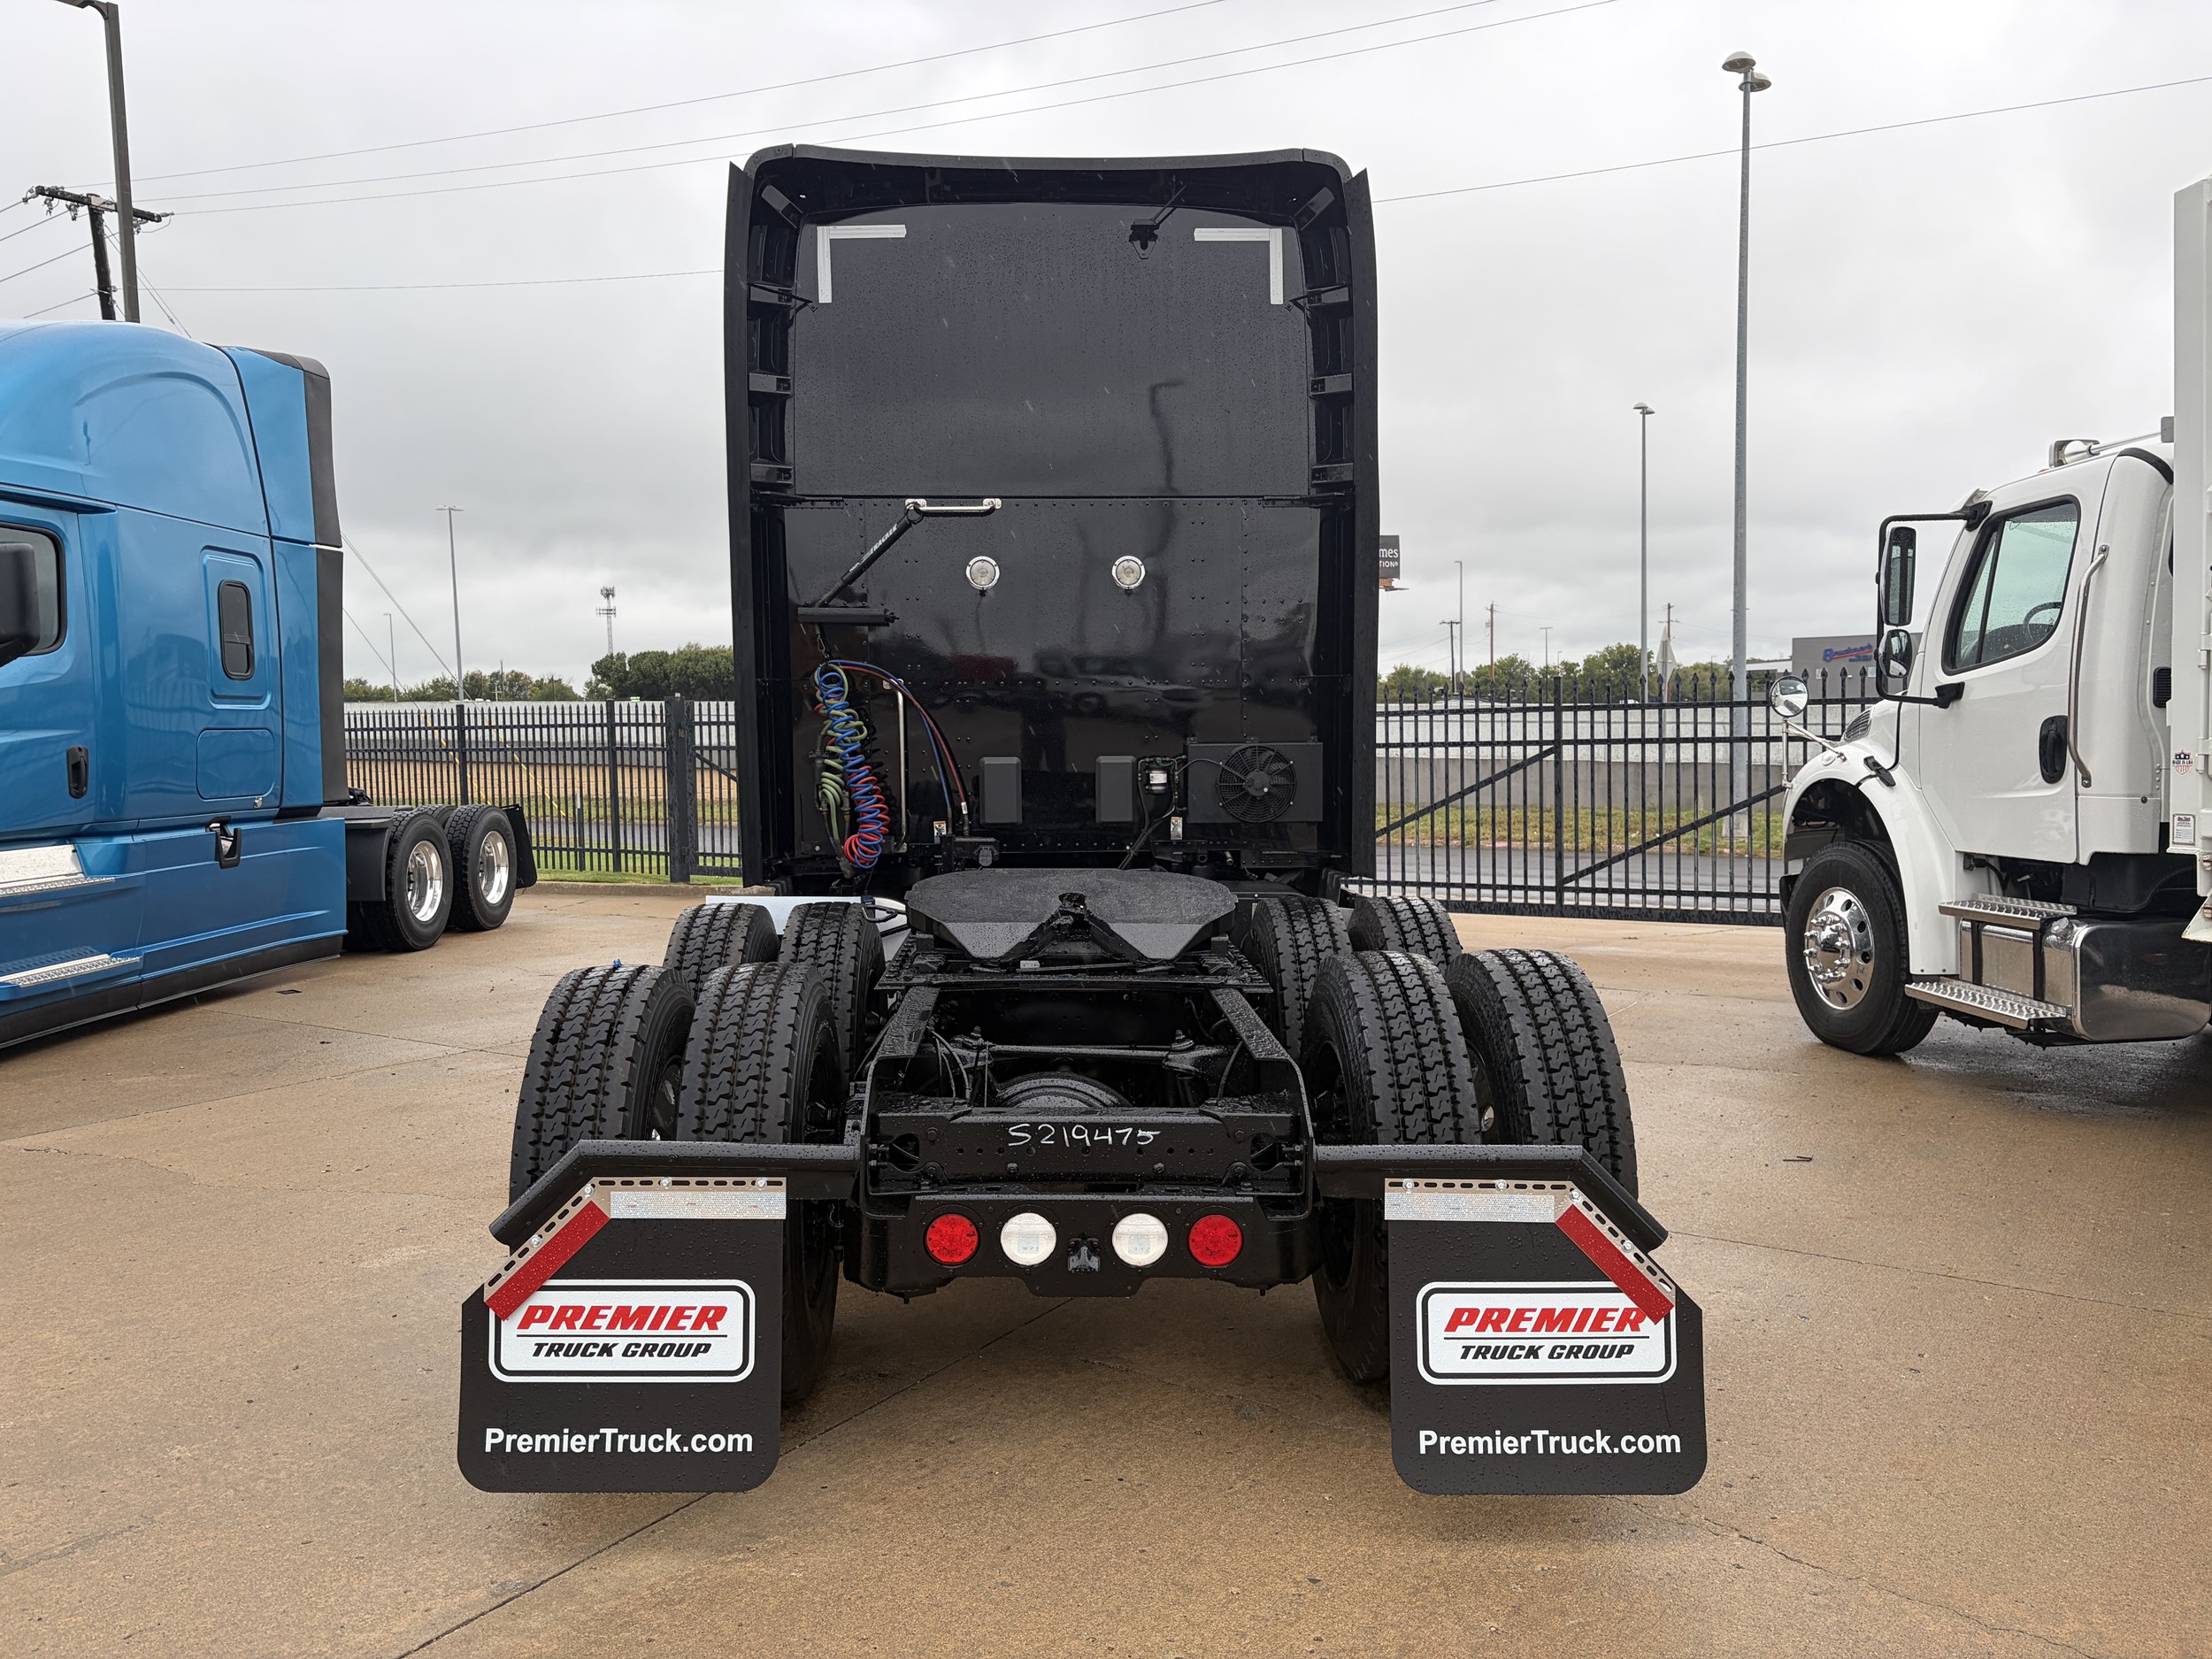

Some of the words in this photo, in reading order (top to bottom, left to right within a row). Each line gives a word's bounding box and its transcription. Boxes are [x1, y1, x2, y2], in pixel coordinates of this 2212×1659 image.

[1008, 1123, 1162, 1148] S219475
[517, 1305, 728, 1331] PREMIER
[1444, 1307, 1647, 1333] PREMIER
[533, 1342, 619, 1357] TRUCK
[621, 1342, 712, 1358] GROUP
[1460, 1344, 1546, 1360] TRUCK
[1548, 1344, 1635, 1360] GROUP
[485, 1427, 753, 1453] PremierTruck.com
[1419, 1429, 1681, 1455] PremierTruck.com
